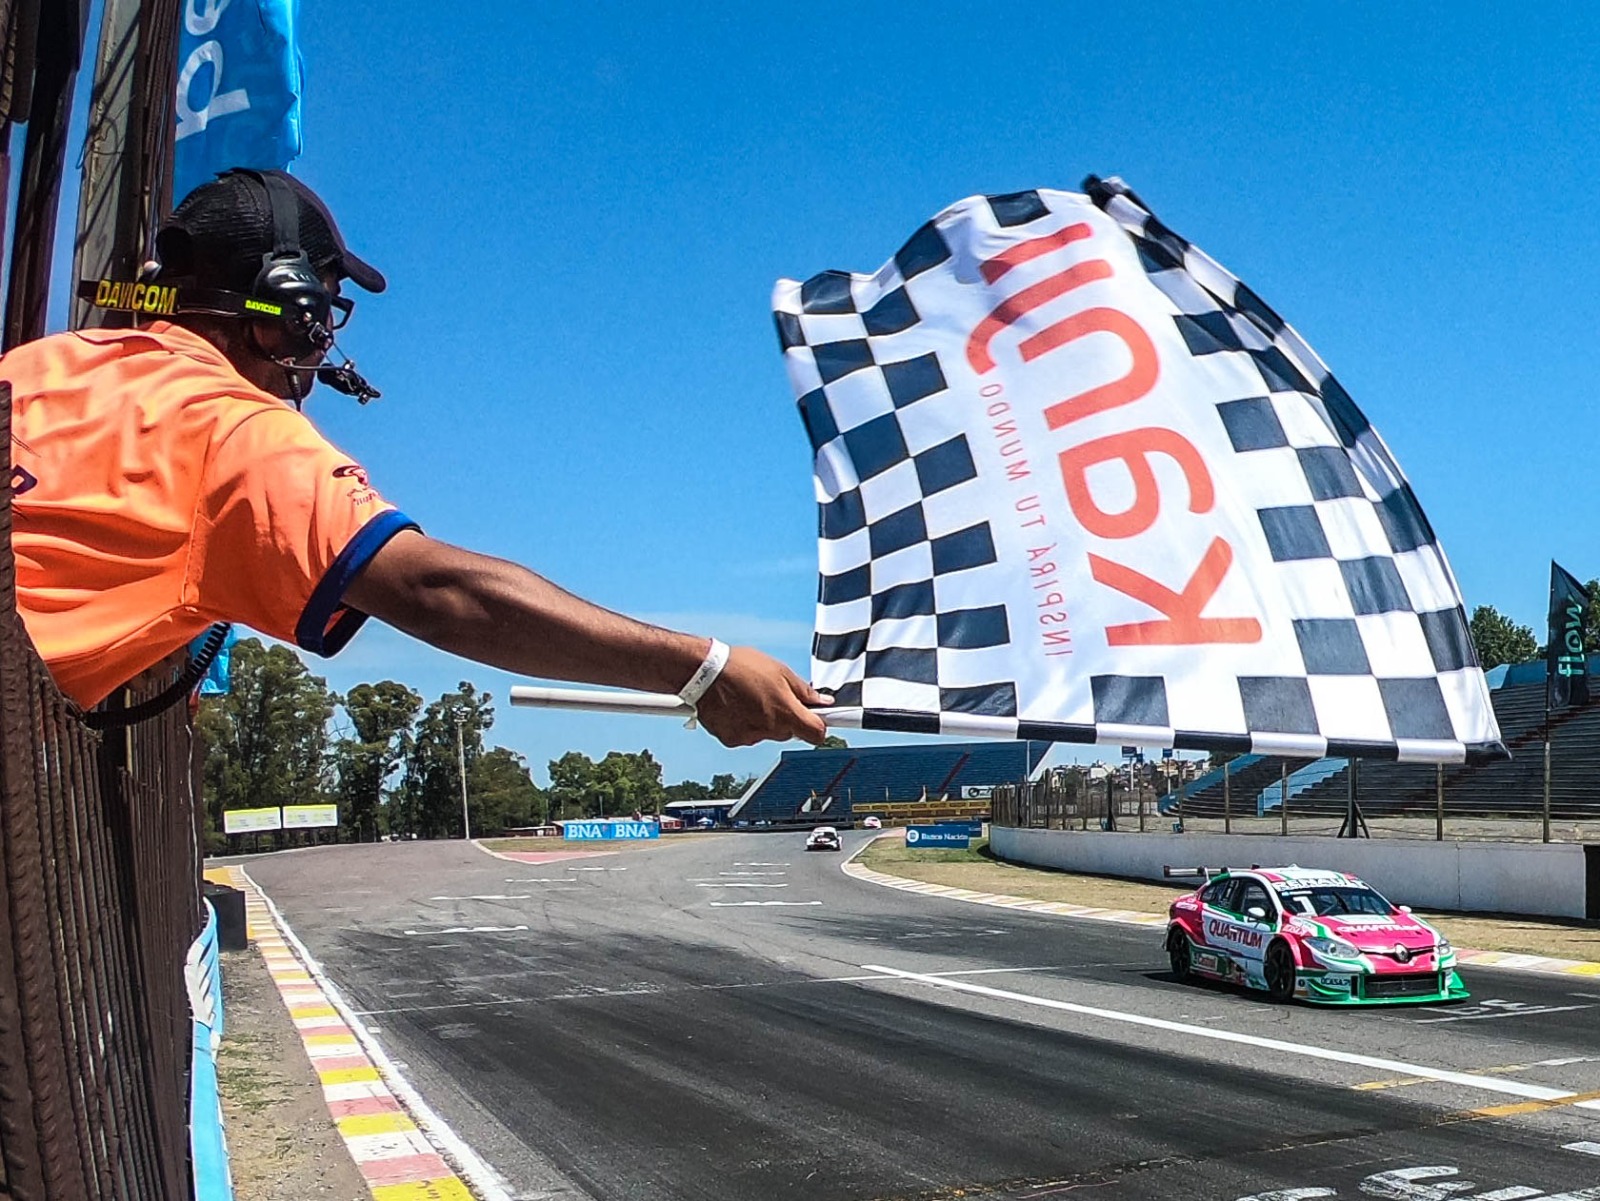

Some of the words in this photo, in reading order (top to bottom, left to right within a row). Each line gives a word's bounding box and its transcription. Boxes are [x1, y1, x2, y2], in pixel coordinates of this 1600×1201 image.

[95, 280, 177, 315] DAVICOM
[245, 300, 282, 315] DAVICOM
[1272, 878, 1369, 891] RENAULT
